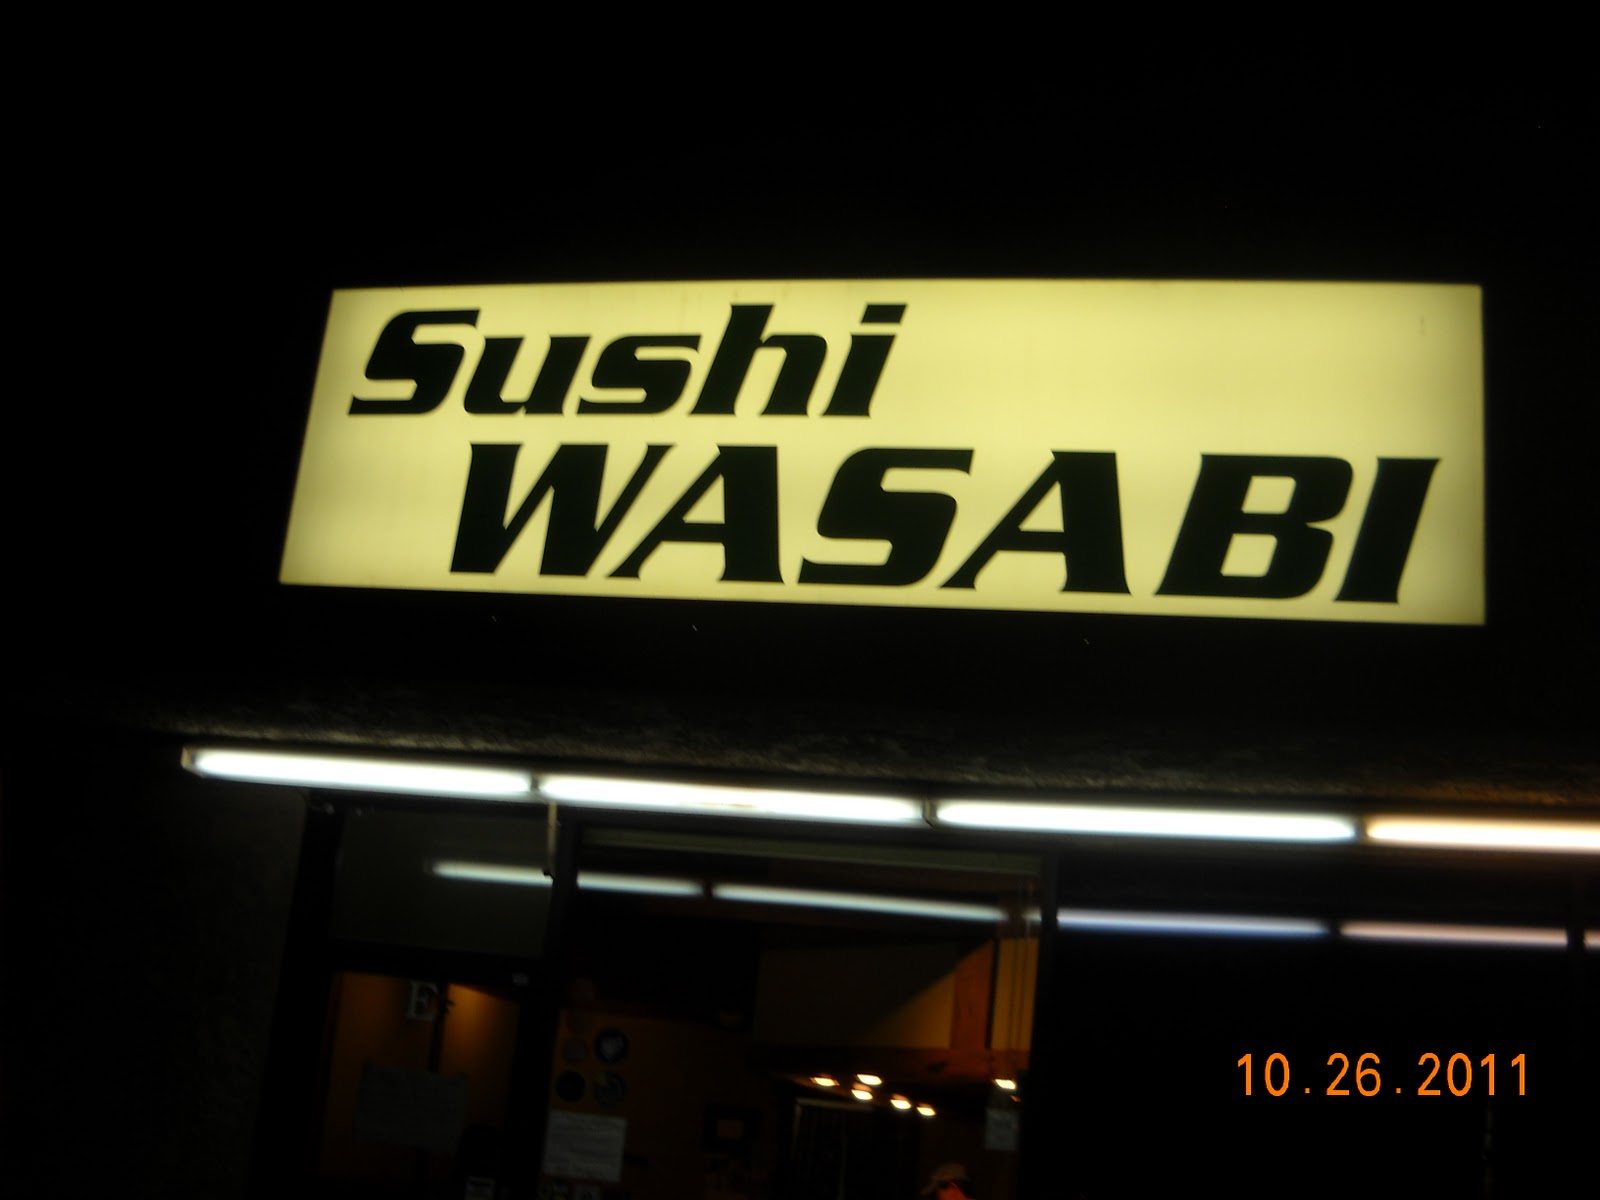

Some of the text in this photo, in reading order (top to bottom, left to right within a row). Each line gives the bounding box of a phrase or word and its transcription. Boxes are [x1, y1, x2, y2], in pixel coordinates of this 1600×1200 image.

[348, 303, 906, 417] Sushi
[450, 443, 1440, 605] WASABI
[407, 979, 441, 1022] E
